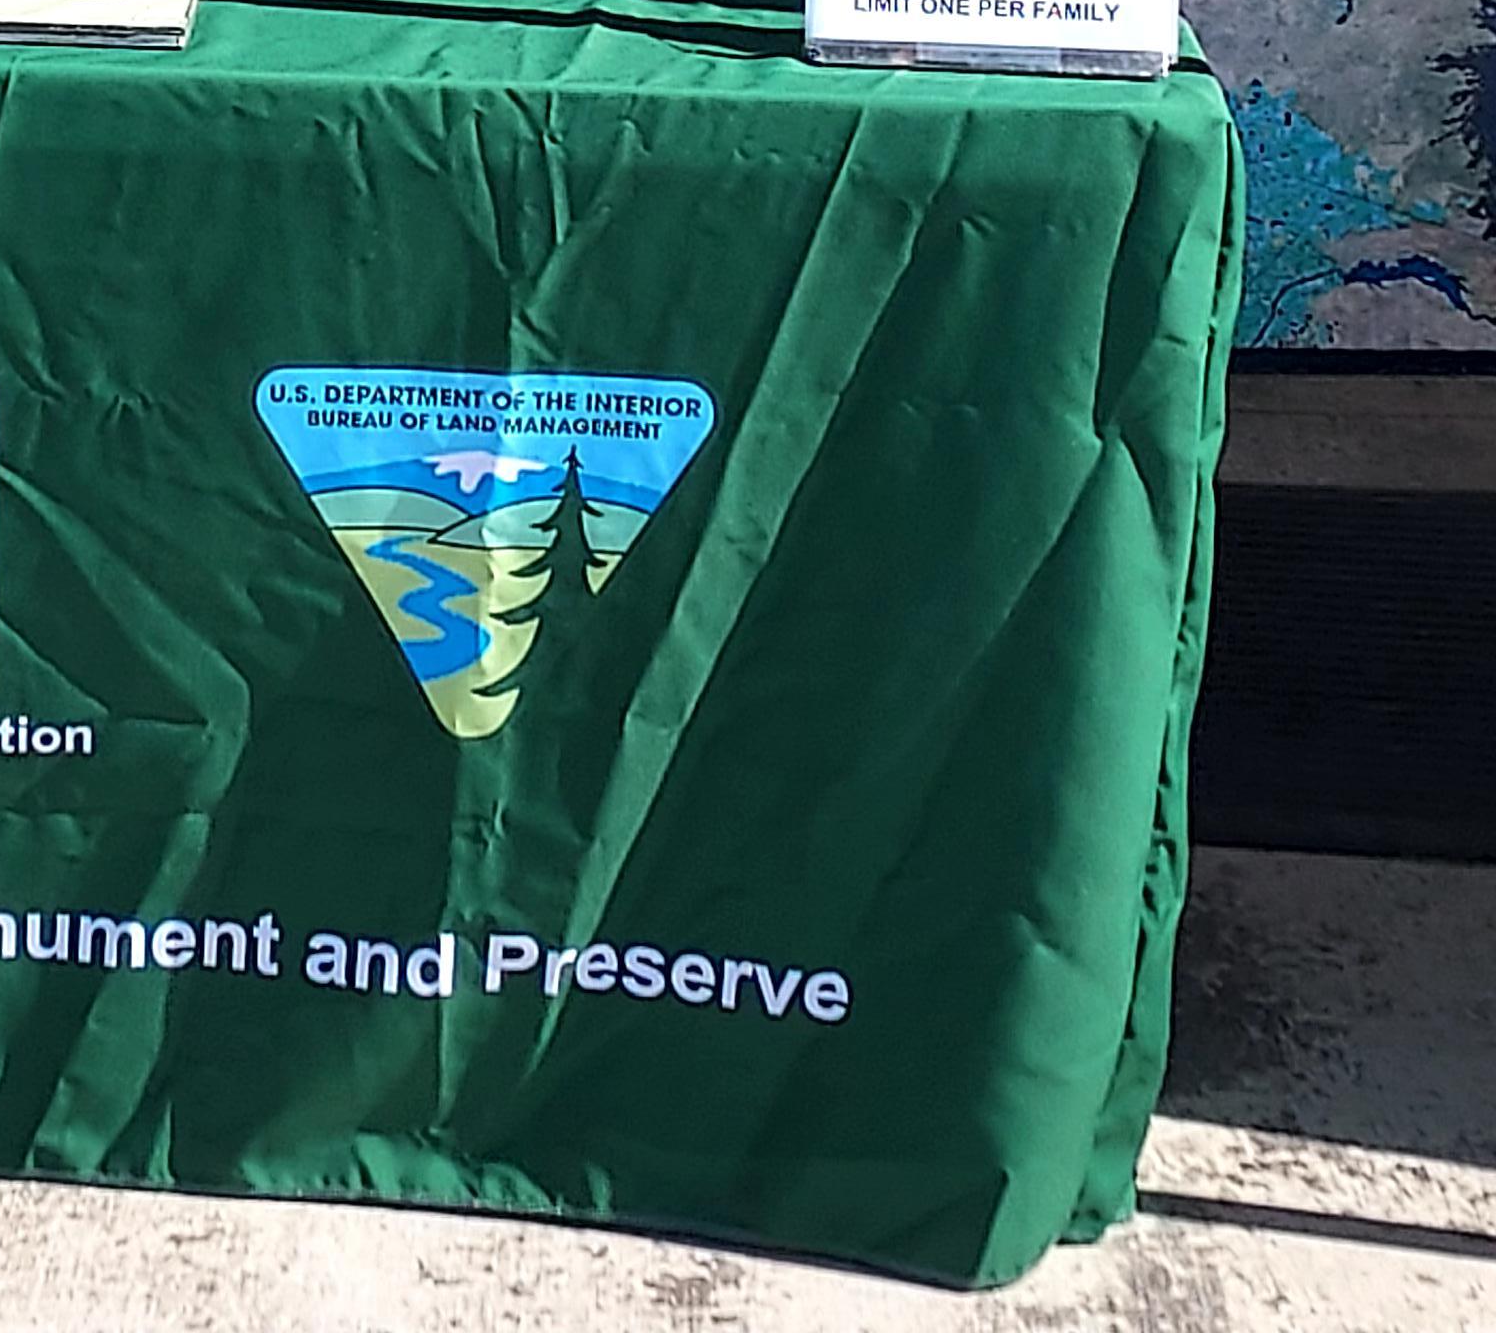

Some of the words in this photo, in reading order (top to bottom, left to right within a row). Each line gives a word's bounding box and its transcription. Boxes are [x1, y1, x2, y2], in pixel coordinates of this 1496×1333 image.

[1033, 0, 1120, 23] FAMILY
[269, 384, 317, 404] U.S.
[324, 384, 487, 410] DEPARTMENT
[492, 390, 526, 412] OF
[532, 391, 578, 412] THE
[585, 392, 703, 419] INTERIOR
[307, 409, 393, 429] BUREAU
[400, 411, 430, 431] OF
[436, 413, 498, 433] LAND
[503, 416, 664, 441] MANAGEMENT
[305, 931, 456, 997] and
[484, 933, 851, 1023] Preserve
